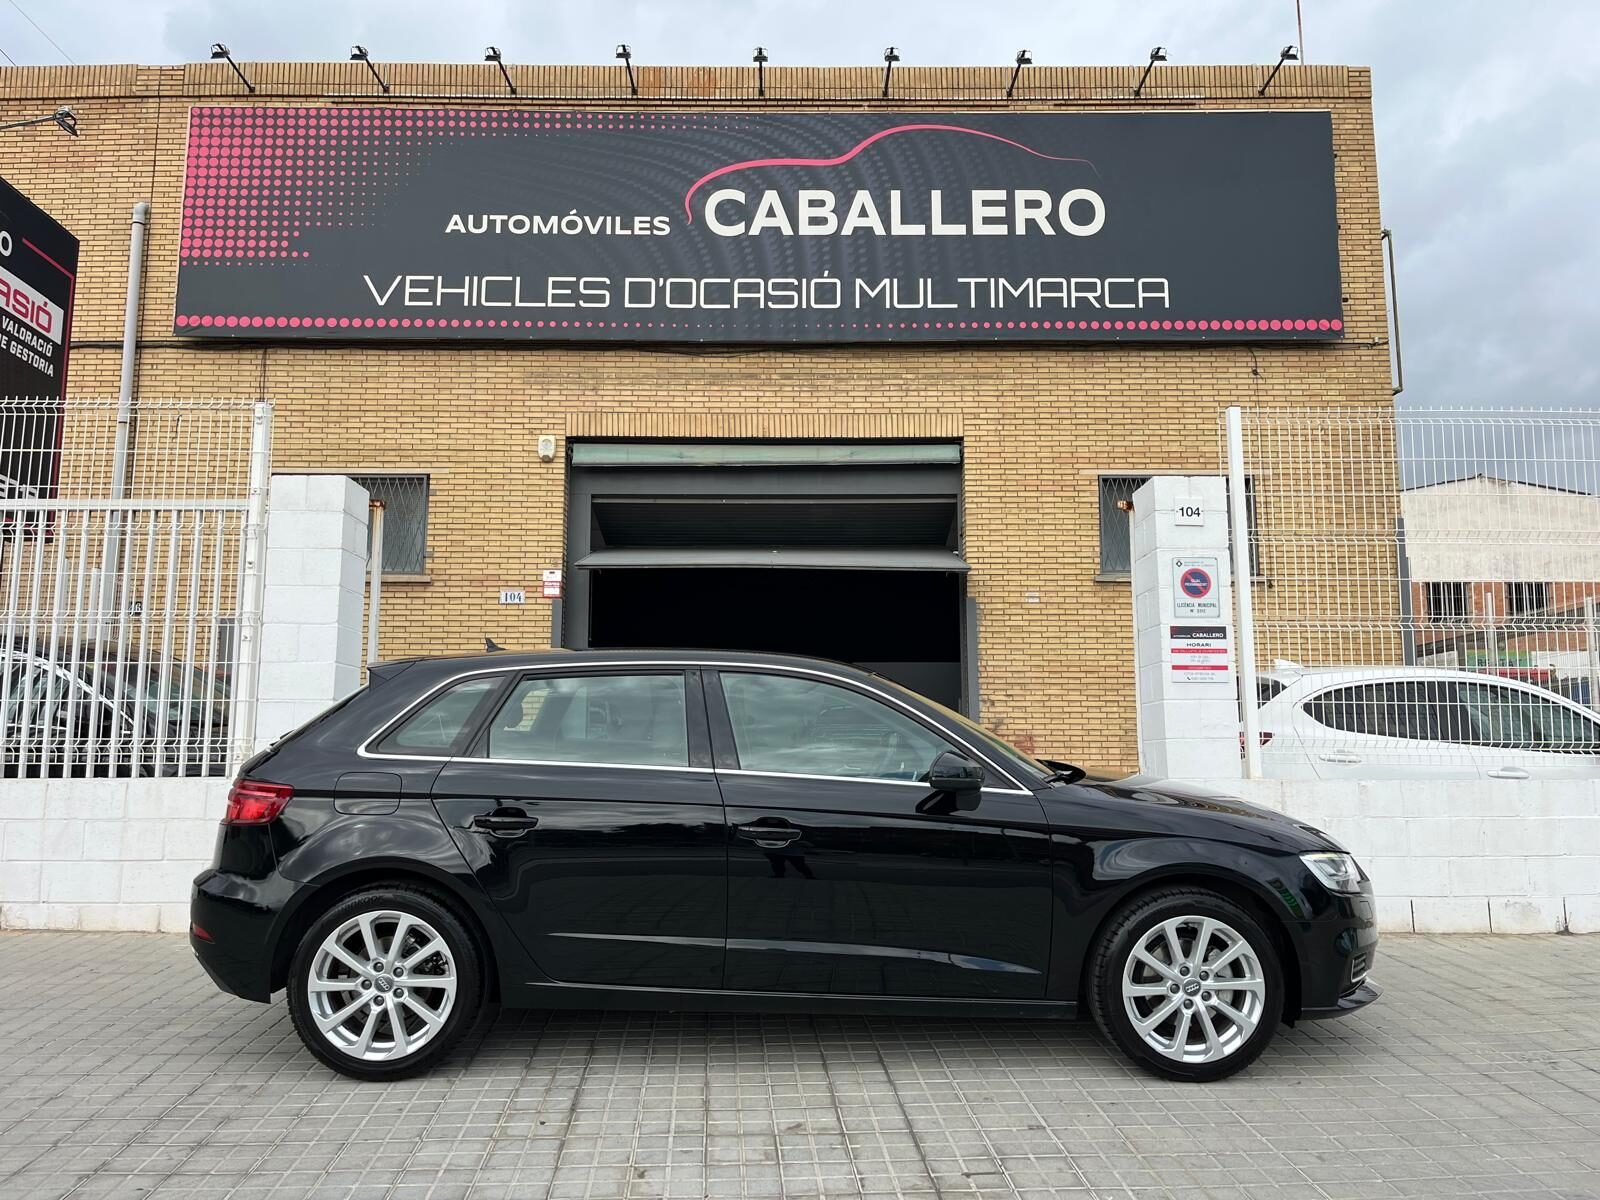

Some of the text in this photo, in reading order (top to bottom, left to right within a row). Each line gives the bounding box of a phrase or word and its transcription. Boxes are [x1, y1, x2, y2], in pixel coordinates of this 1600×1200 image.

[444, 187, 1107, 238] AUTOMÓVILES CABALLERO
[363, 270, 1170, 311] VEHICLES D'OCASIÓ MULTIMARCA
[2, 316, 53, 357] VALORACIÓ
[10, 341, 54, 377] GESTORIA
[1178, 505, 1201, 518] 104
[504, 592, 522, 602] 104
